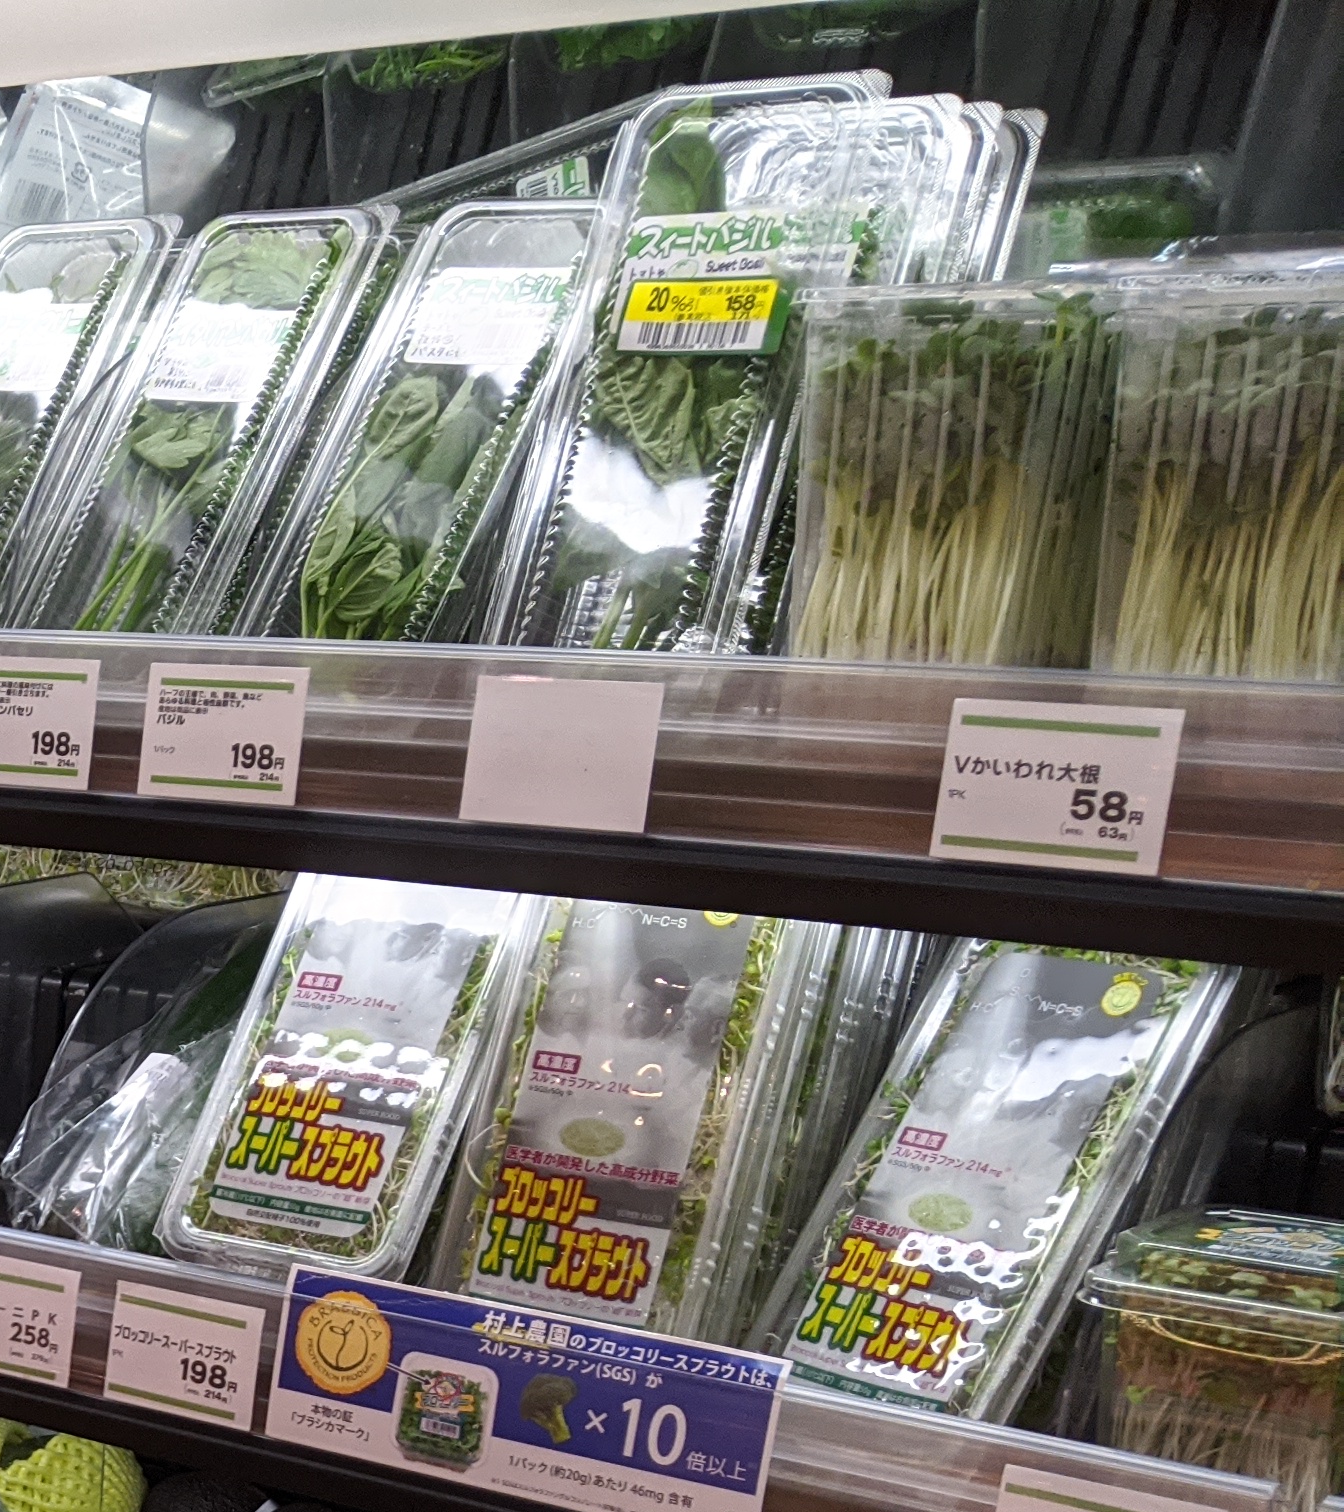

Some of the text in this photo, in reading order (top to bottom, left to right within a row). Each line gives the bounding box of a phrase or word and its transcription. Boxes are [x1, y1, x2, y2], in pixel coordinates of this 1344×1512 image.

[156, 712, 186, 726] バジル
[31, 730, 80, 757] 198円
[230, 742, 285, 770] 198円
[954, 753, 1102, 786] Vかいわれ大根
[1069, 789, 1145, 826] 58円
[641, 912, 688, 930] N=C=S
[294, 990, 361, 1008] スルフォラファン
[529, 1071, 606, 1091] スルフォラファン
[226, 1117, 386, 1194] スーパースプラウト
[505, 1145, 680, 1187] 医学者が開発した高成分野菜
[891, 1146, 964, 1170] スルフォラファン
[497, 1165, 600, 1226] ブロッコリー
[477, 1216, 653, 1302] スーパースプラウト
[9, 1321, 58, 1354] 258円
[113, 1323, 237, 1364] ブロッコリースーパースプラウト
[178, 1356, 238, 1394] 198円
[310, 1402, 354, 1423] 本物の証
[620, 1397, 686, 1466] 10
[686, 1450, 748, 1482] 倍以上
[630, 1482, 694, 1509] 46mg 含有
